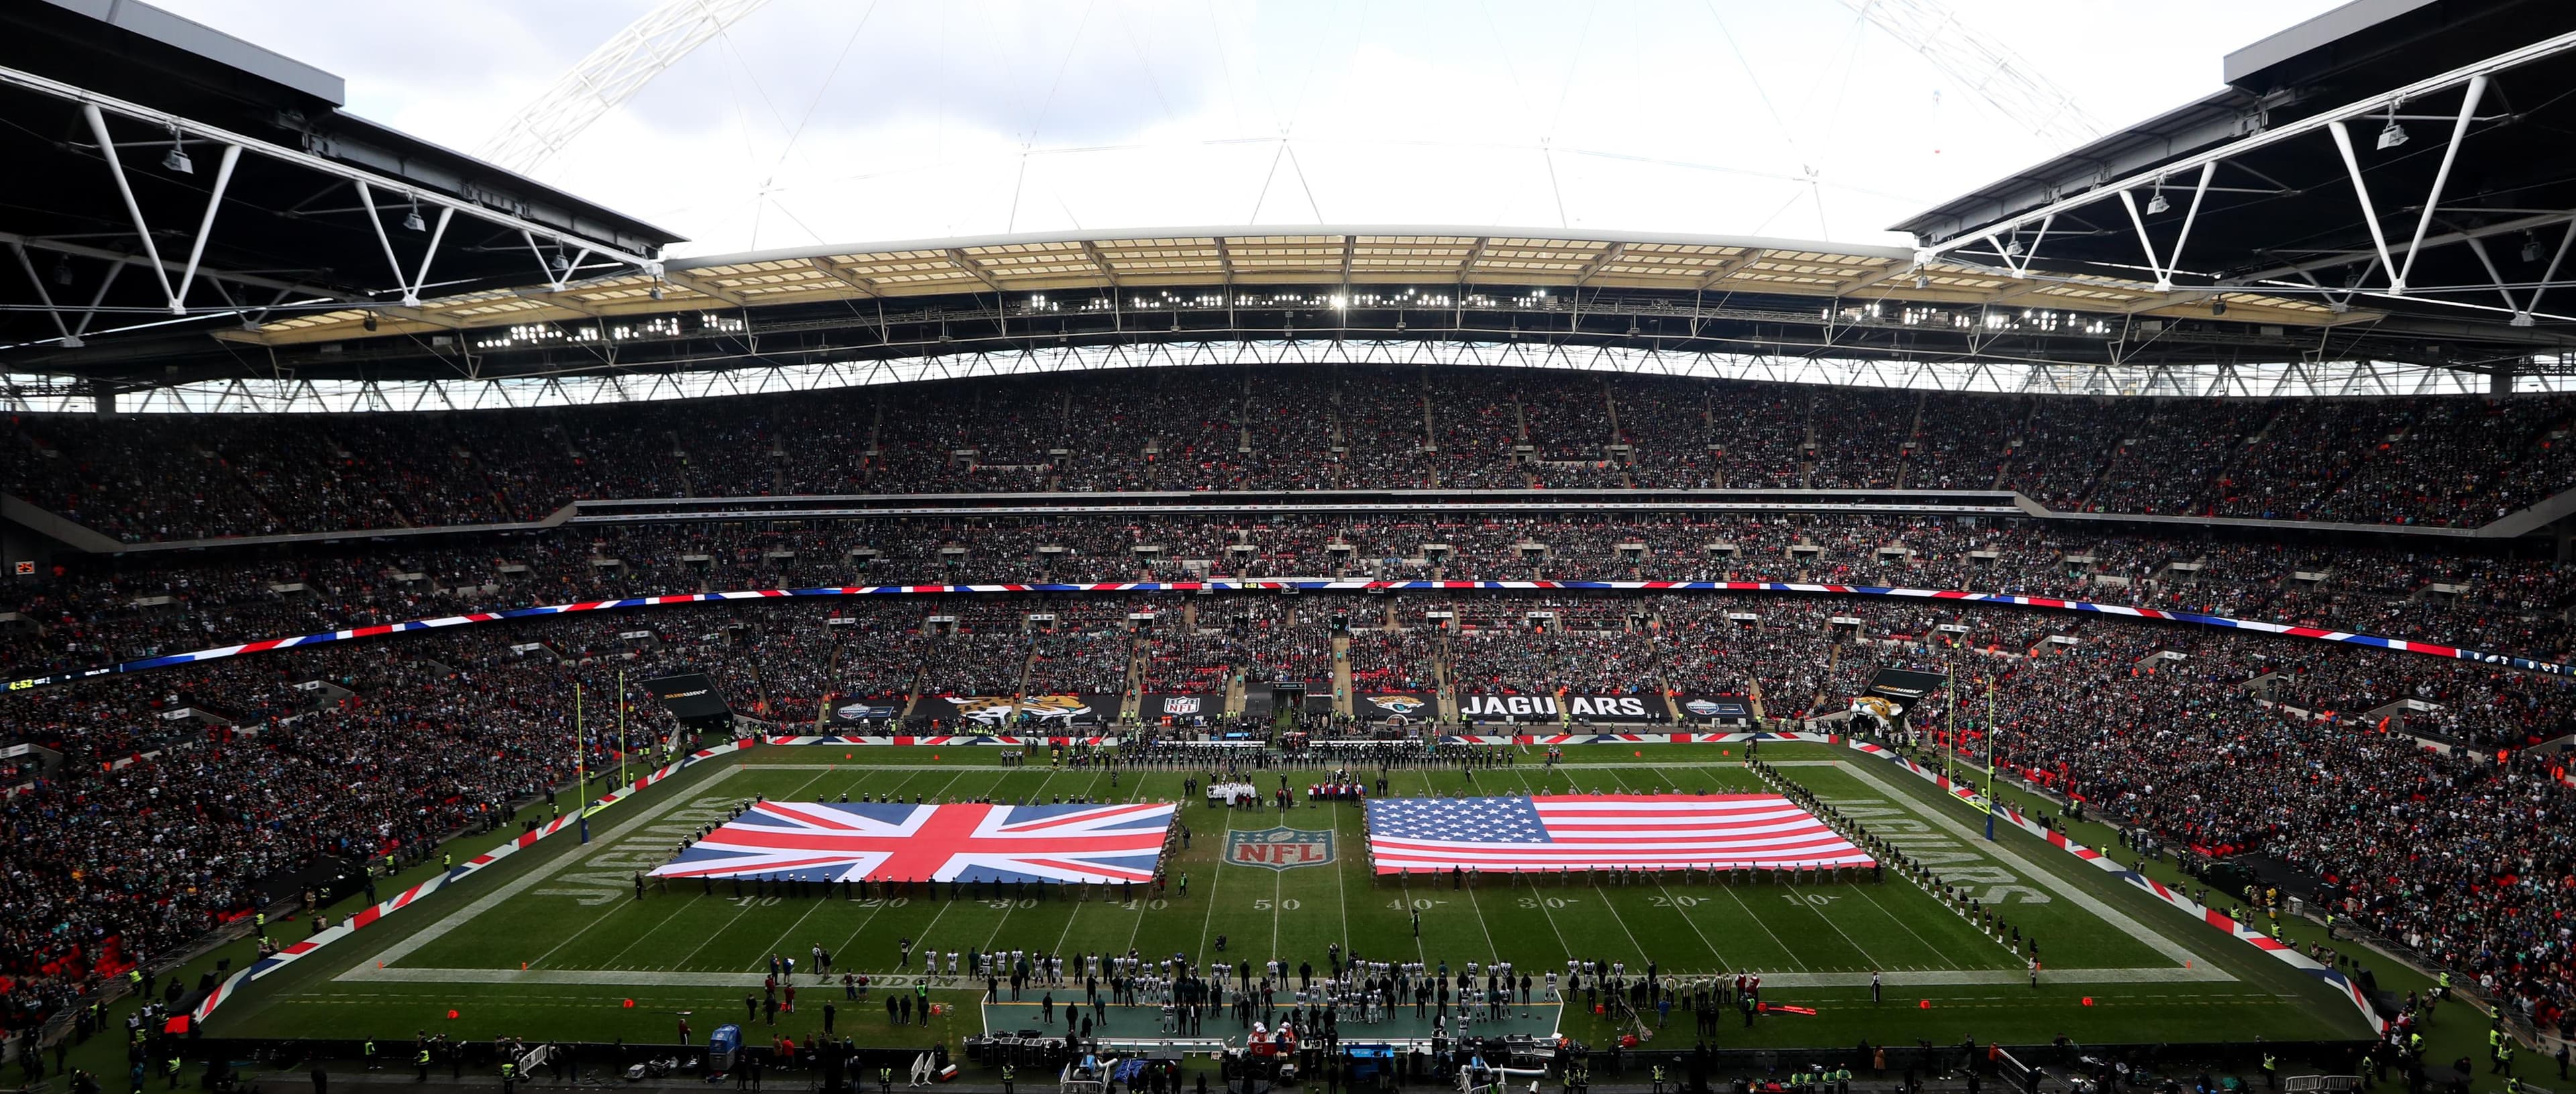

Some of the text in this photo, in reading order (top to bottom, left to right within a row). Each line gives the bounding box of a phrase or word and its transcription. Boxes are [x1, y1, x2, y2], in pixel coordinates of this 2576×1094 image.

[17, 563, 33, 573] 25
[9, 679, 34, 691] 4:52
[664, 689, 708, 699] SUBWAY
[1236, 843, 1324, 865] NFL
[735, 895, 782, 907] 10
[858, 897, 909, 908] 20
[989, 898, 1038, 910] 30
[1122, 898, 1169, 911] 40
[1253, 899, 1301, 911] 50
[1386, 899, 1433, 911] 40
[1517, 897, 1566, 910] 30
[1648, 895, 1697, 908] 20
[1781, 893, 1829, 906] 10
